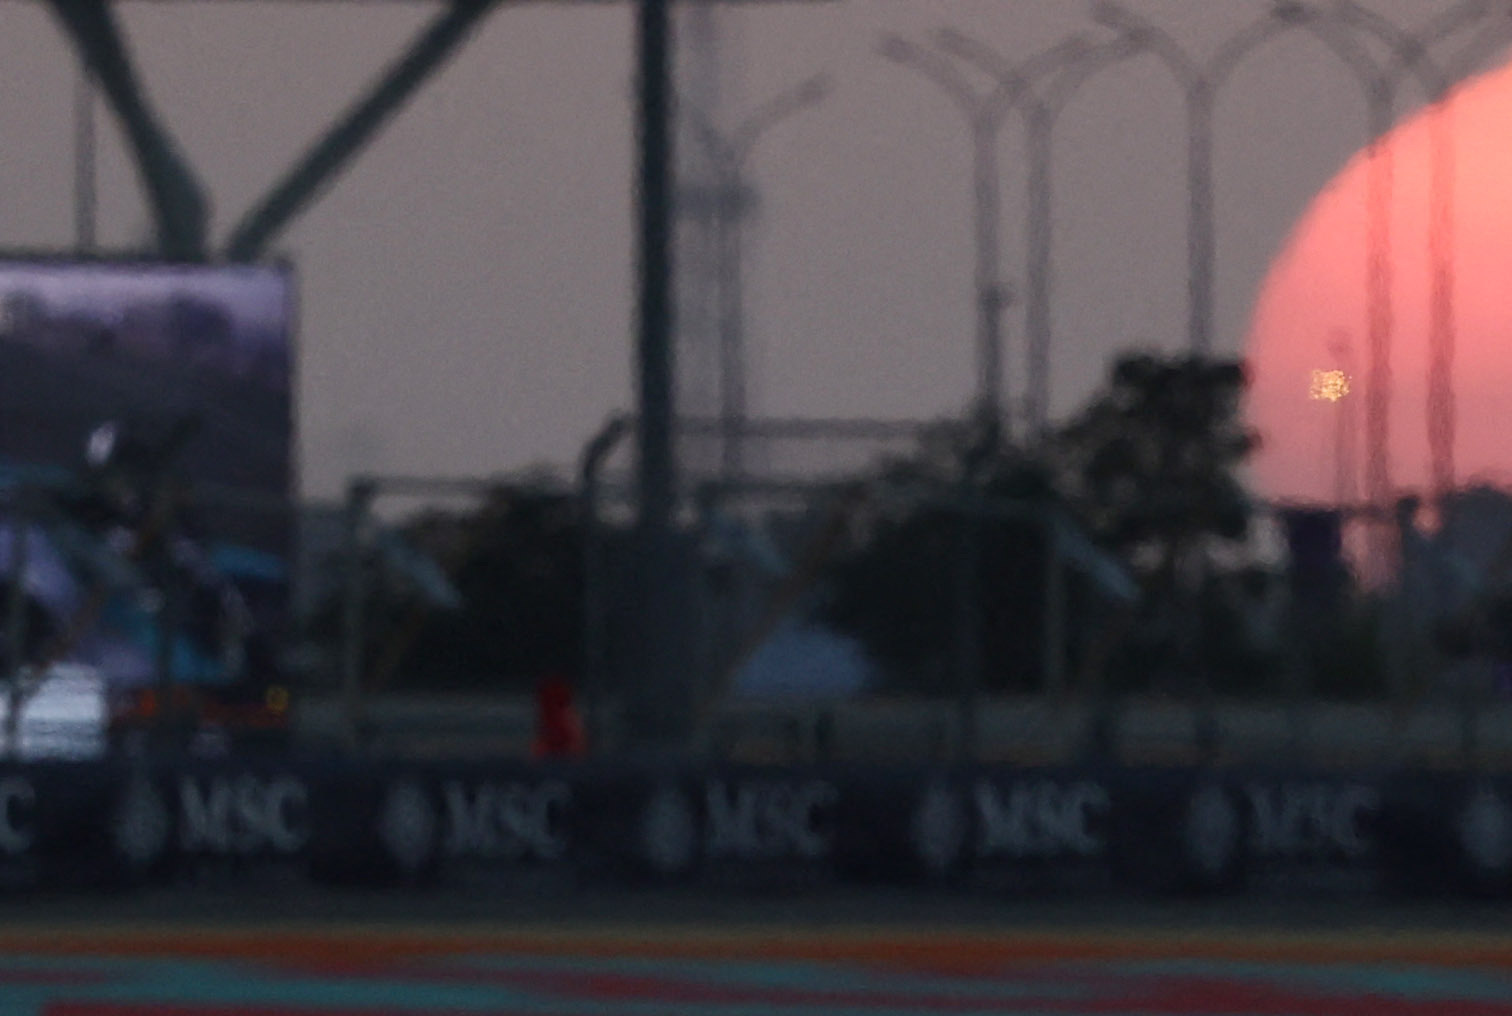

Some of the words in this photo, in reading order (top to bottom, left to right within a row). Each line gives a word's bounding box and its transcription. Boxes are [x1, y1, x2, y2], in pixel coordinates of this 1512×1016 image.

[179, 775, 305, 853] MSC
[440, 779, 570, 858] MSC
[702, 778, 838, 857] MSC
[974, 778, 1110, 857] MSC
